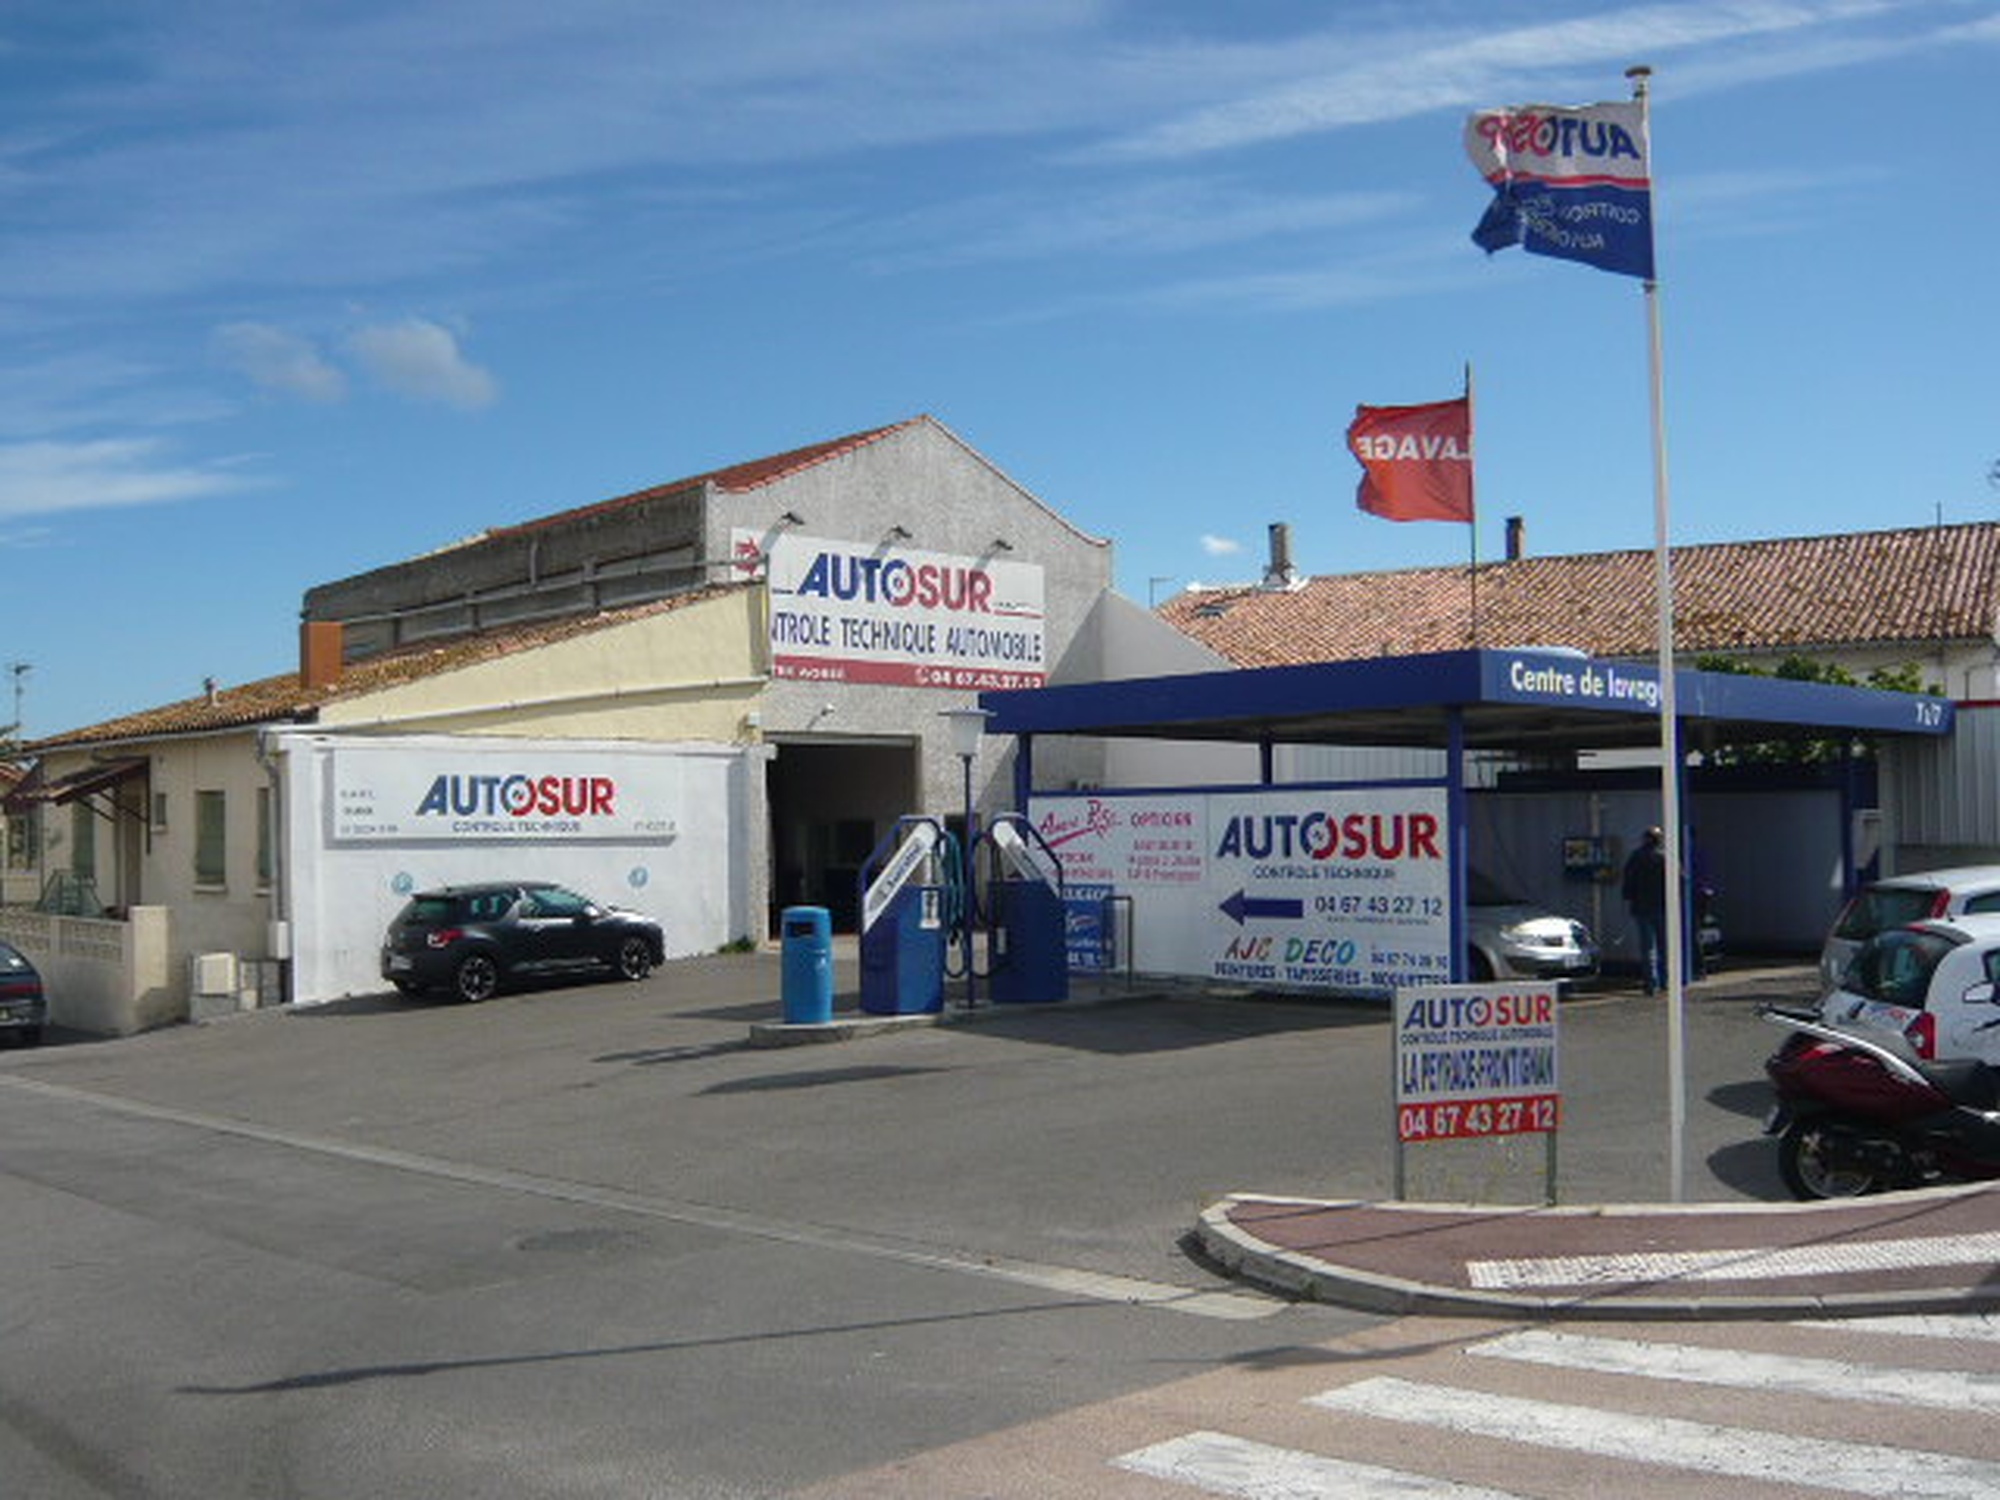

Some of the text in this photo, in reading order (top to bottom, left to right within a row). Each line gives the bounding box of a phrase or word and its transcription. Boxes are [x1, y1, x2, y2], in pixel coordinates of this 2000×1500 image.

[797, 553, 992, 613] AUTOSUR
[841, 618, 936, 655] TECHNIQUE
[946, 627, 1042, 663] AUTOMOBILE
[1511, 661, 1664, 708] Centre de lavag
[416, 774, 615, 817] AUTOSUR
[1216, 812, 1442, 860] AUTOSUR
[1315, 896, 1442, 917] 04 67 43 27 12
[1284, 937, 1356, 966] DECO
[1403, 994, 1552, 1030] AUTOSUR
[1401, 1100, 1555, 1138] 04 67 43 27 12
